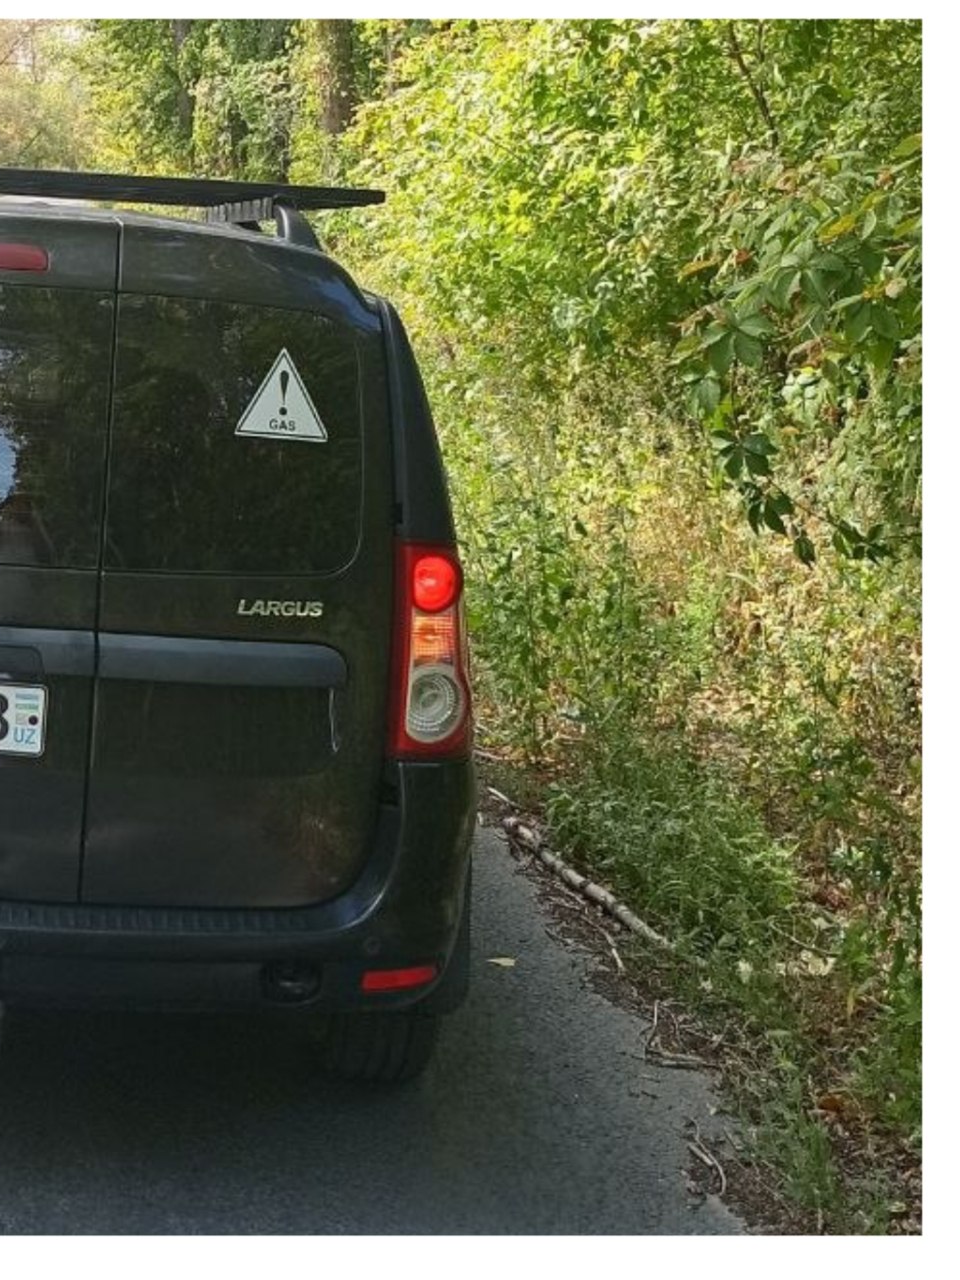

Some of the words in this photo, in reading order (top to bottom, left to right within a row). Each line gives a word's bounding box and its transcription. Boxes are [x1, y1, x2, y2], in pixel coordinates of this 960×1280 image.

[269, 419, 296, 432] GAS
[237, 599, 324, 617] LARGUS
[13, 727, 36, 744] UZ
